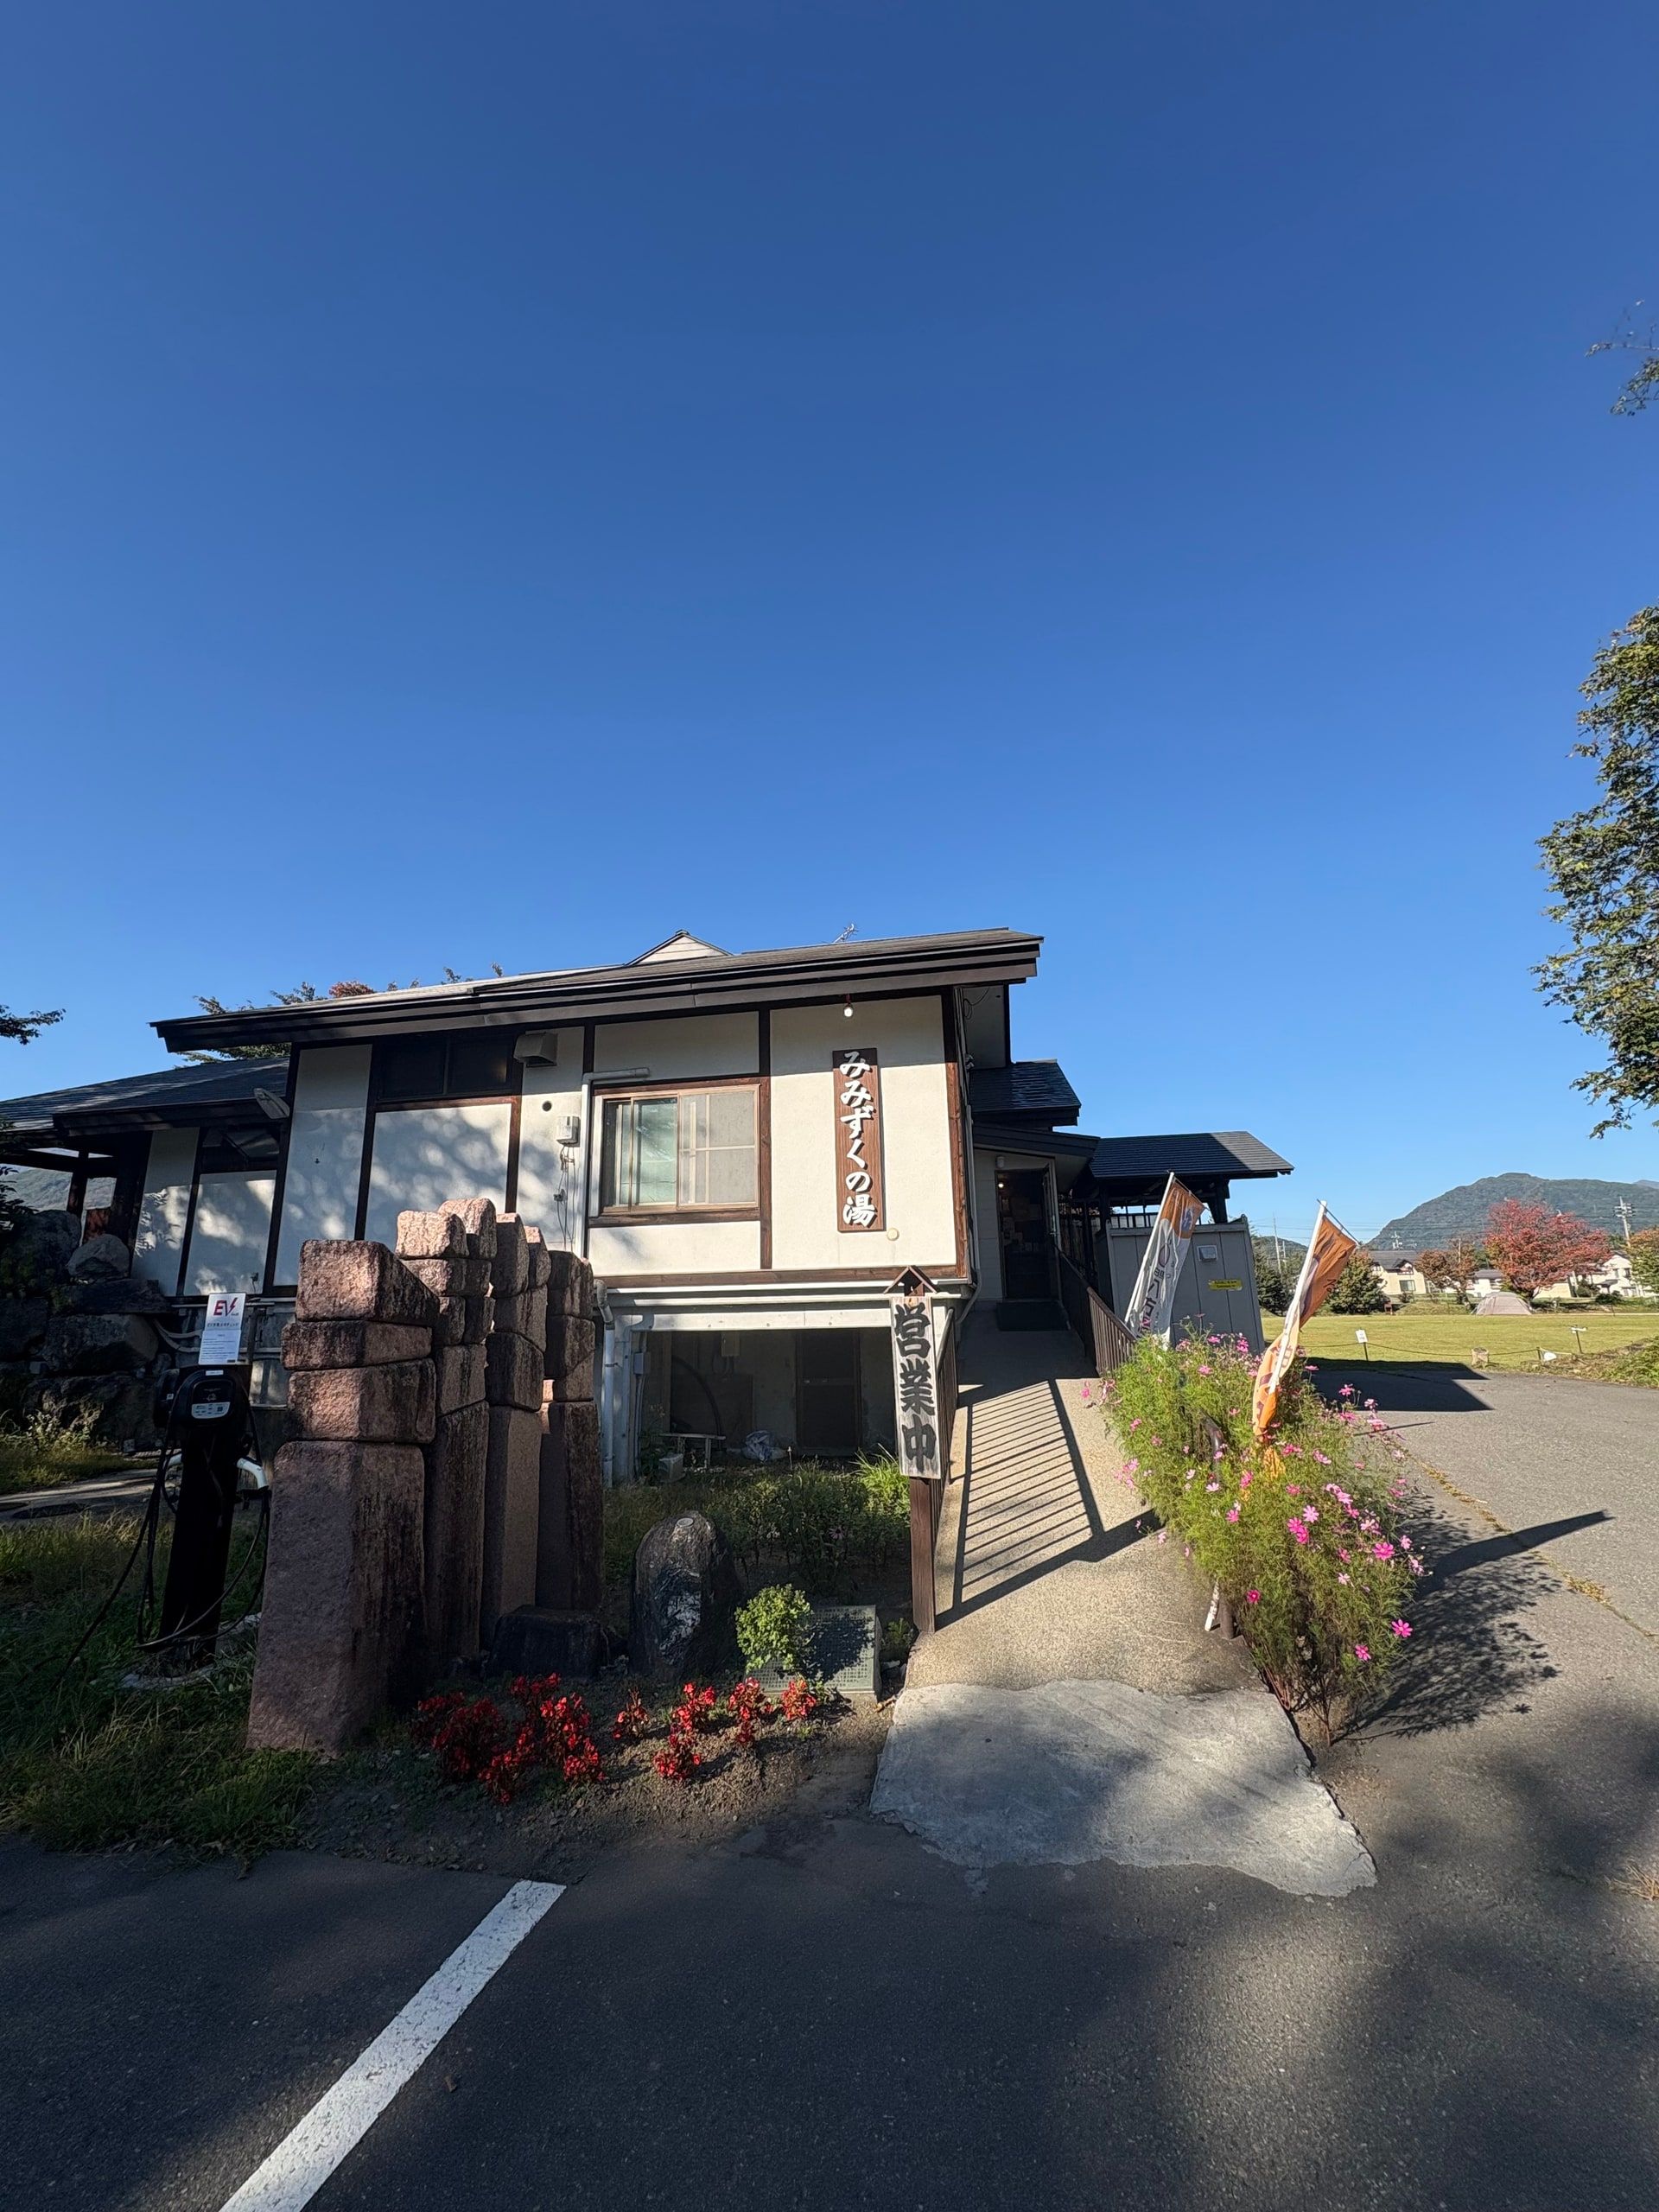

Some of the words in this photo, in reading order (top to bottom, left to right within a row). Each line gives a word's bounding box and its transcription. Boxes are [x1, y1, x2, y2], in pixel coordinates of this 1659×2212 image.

[839, 1051, 874, 1227] みみずくの湯
[213, 1298, 238, 1316] EV
[894, 1302, 937, 1472] 営業中
